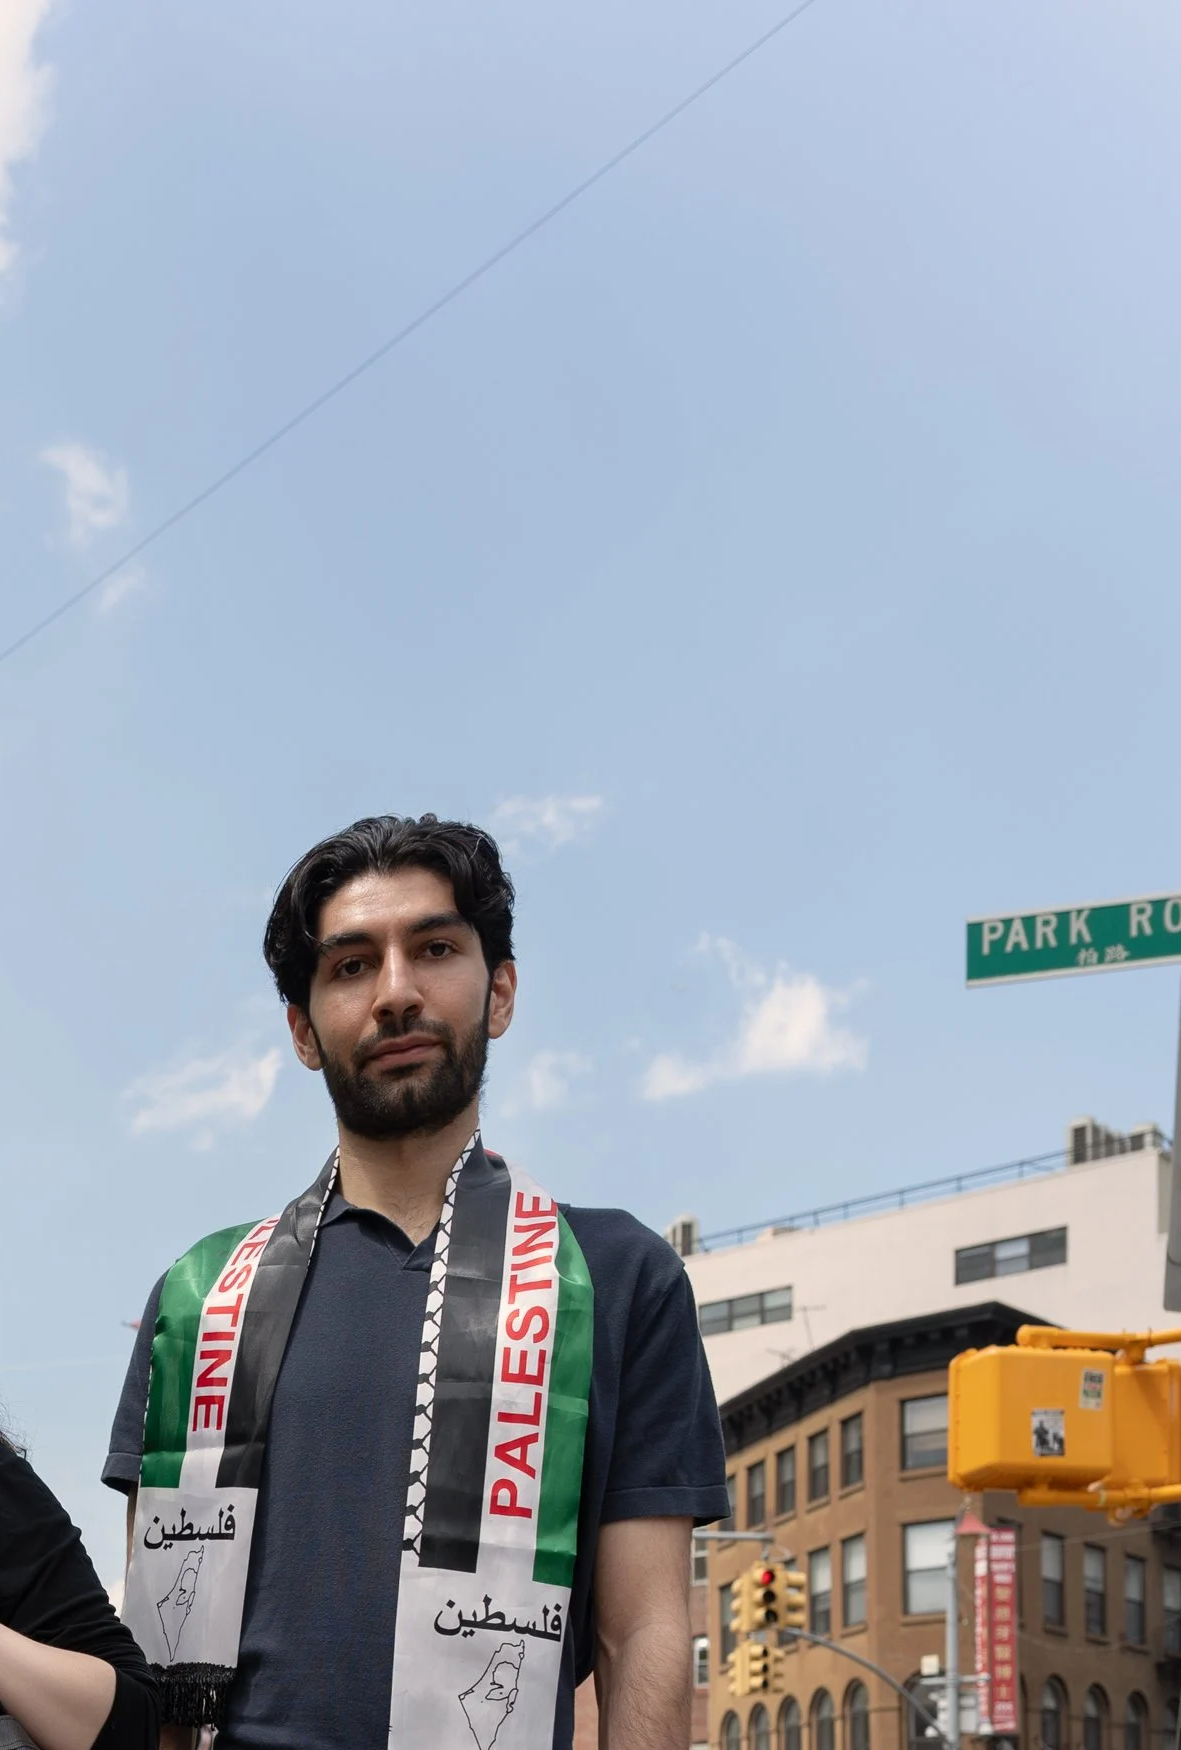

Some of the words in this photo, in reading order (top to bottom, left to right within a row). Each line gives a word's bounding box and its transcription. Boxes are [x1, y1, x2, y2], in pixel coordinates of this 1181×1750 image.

[981, 909, 1093, 957] PARK
[192, 1218, 281, 1433] LESTINE
[489, 1190, 558, 1519] PALESTINE
[143, 1503, 237, 1550] فلسطين
[433, 1594, 564, 1643] فلسطين
